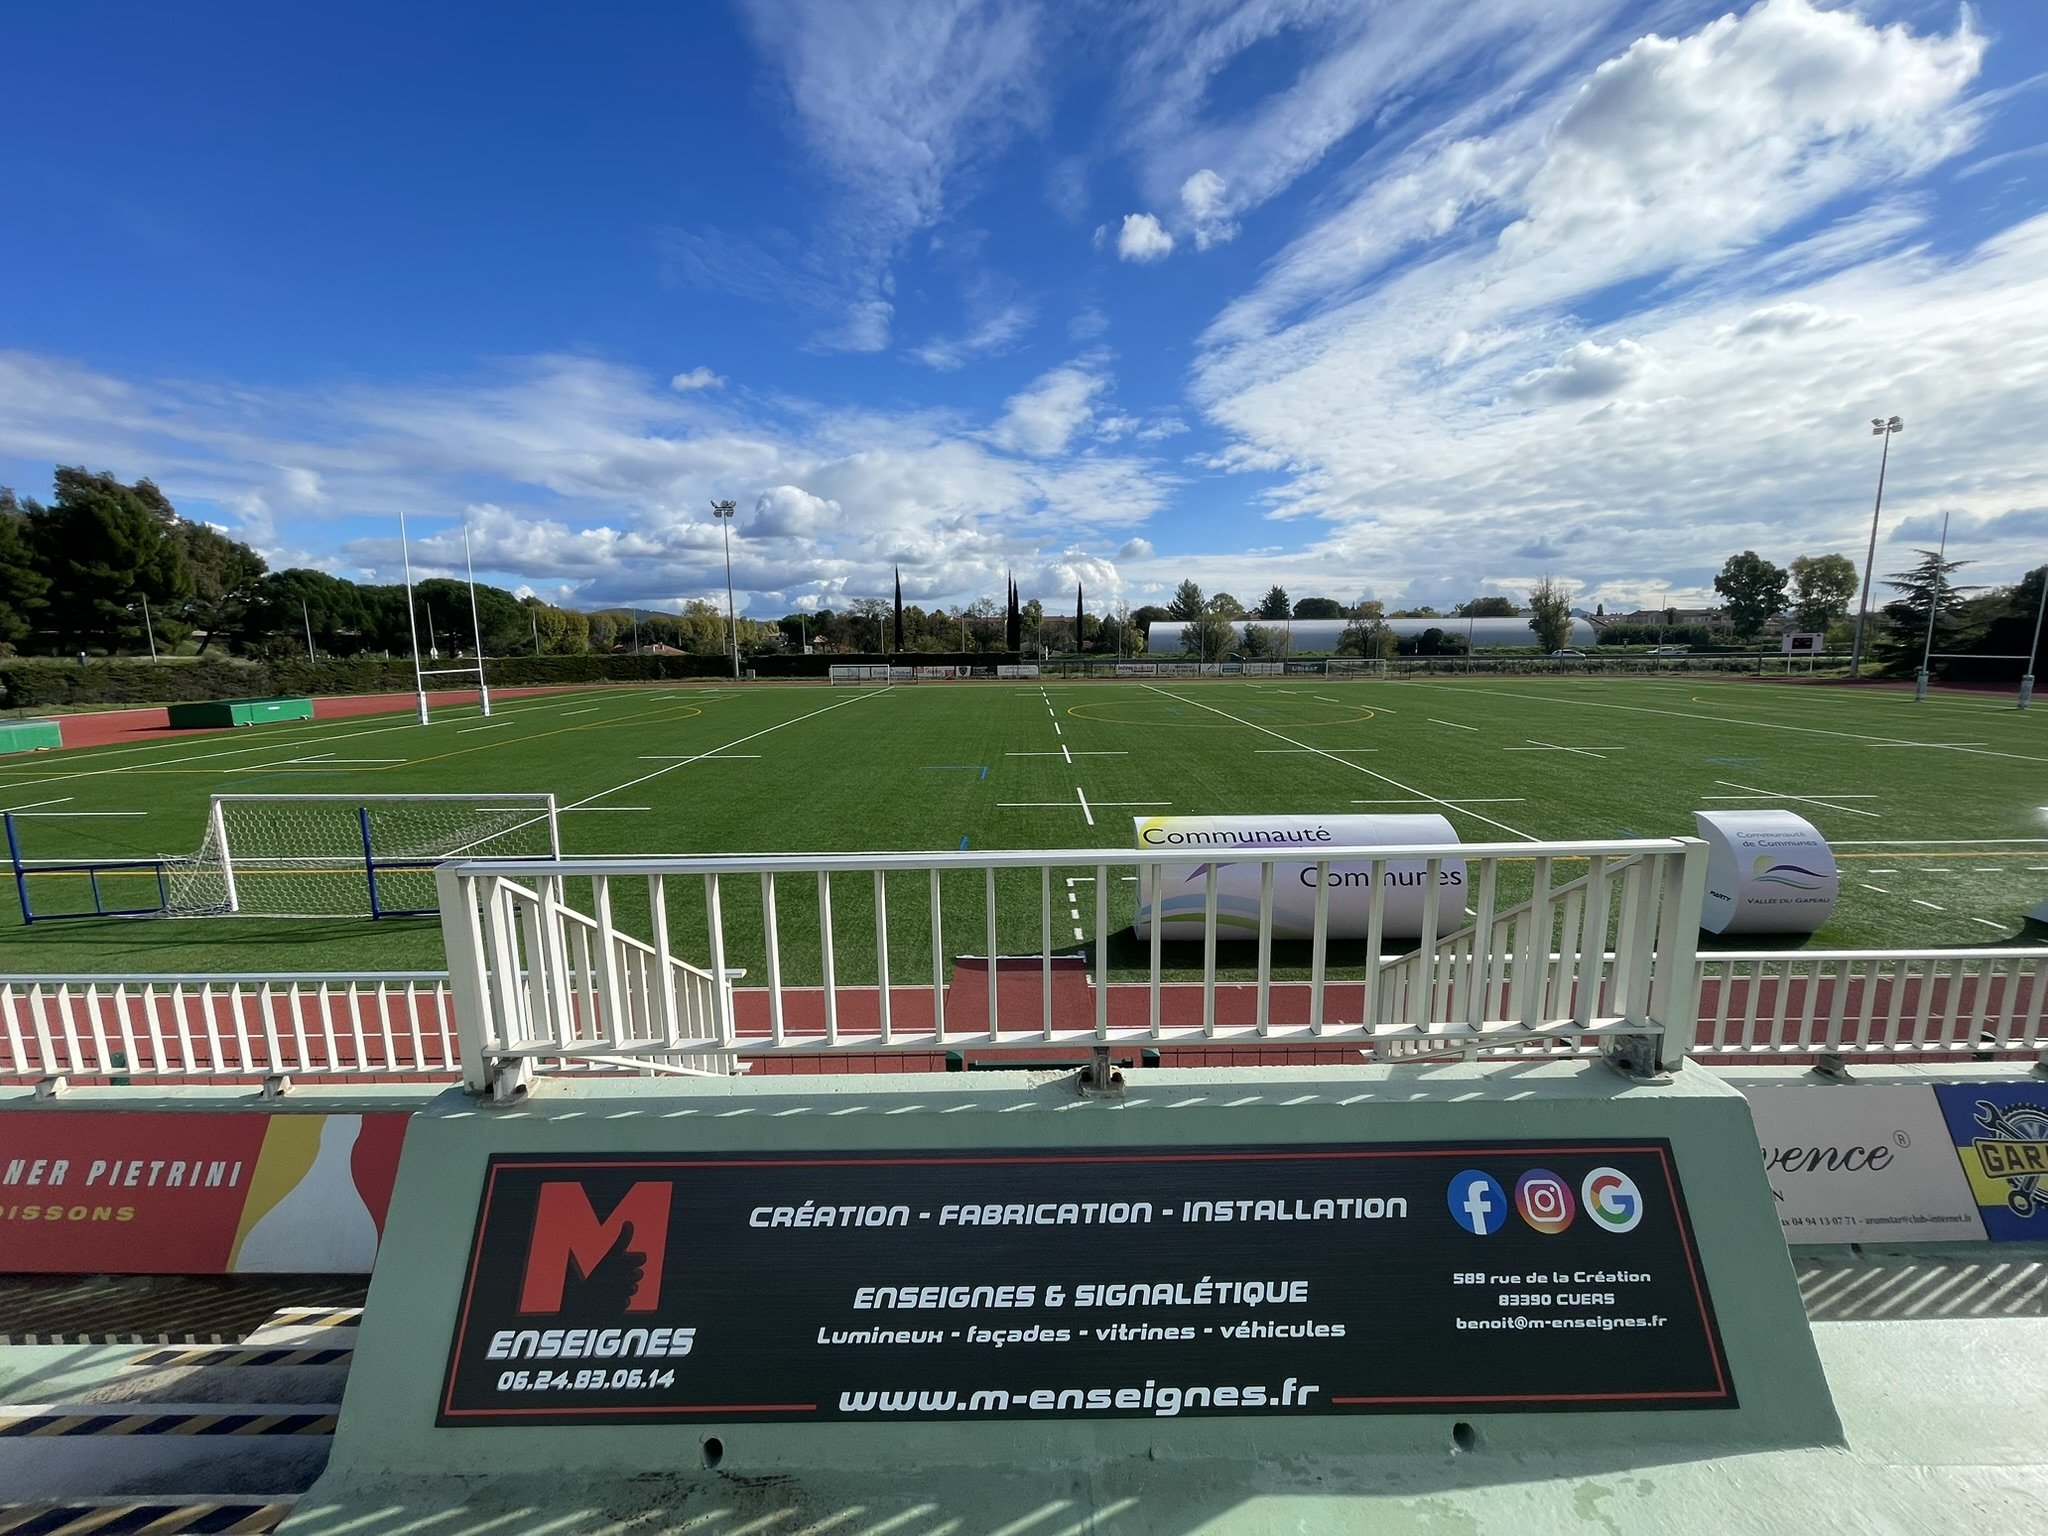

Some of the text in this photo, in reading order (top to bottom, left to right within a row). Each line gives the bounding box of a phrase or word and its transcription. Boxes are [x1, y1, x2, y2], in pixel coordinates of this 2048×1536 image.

[1142, 825, 1332, 845] Communauté
[1736, 831, 1807, 839] Communauté
[1742, 839, 1818, 848] de Communes
[1981, 1144, 2048, 1172] GAR
[2, 1159, 243, 1188] NER PIETRINI
[749, 1199, 910, 1228] CRÉATION
[938, 1202, 1153, 1226] FABRICATION
[1182, 1197, 1408, 1223] INSTALLATION
[1792, 1216, 1803, 1226] 04
[1805, 1216, 1817, 1226] 94
[1819, 1216, 1831, 1226] 13
[1453, 1270, 1651, 1285] 589 rue de la Création
[852, 1275, 1309, 1310] ENSEIGNES & SIGNALÉTIQUE
[1498, 1293, 1615, 1307] 83390 CUERS
[817, 1326, 944, 1345] Lumineux
[966, 1324, 1071, 1348] façades
[1095, 1322, 1196, 1341] vitrines
[1219, 1319, 1346, 1339] véhicules
[1456, 1314, 1668, 1331] benoit@m-enseignes.fr
[485, 1327, 697, 1360] ENSEIGNES
[496, 1368, 675, 1391] 06.24.83.06.14
[839, 1377, 1320, 1417] www.m-enseignes.fr
